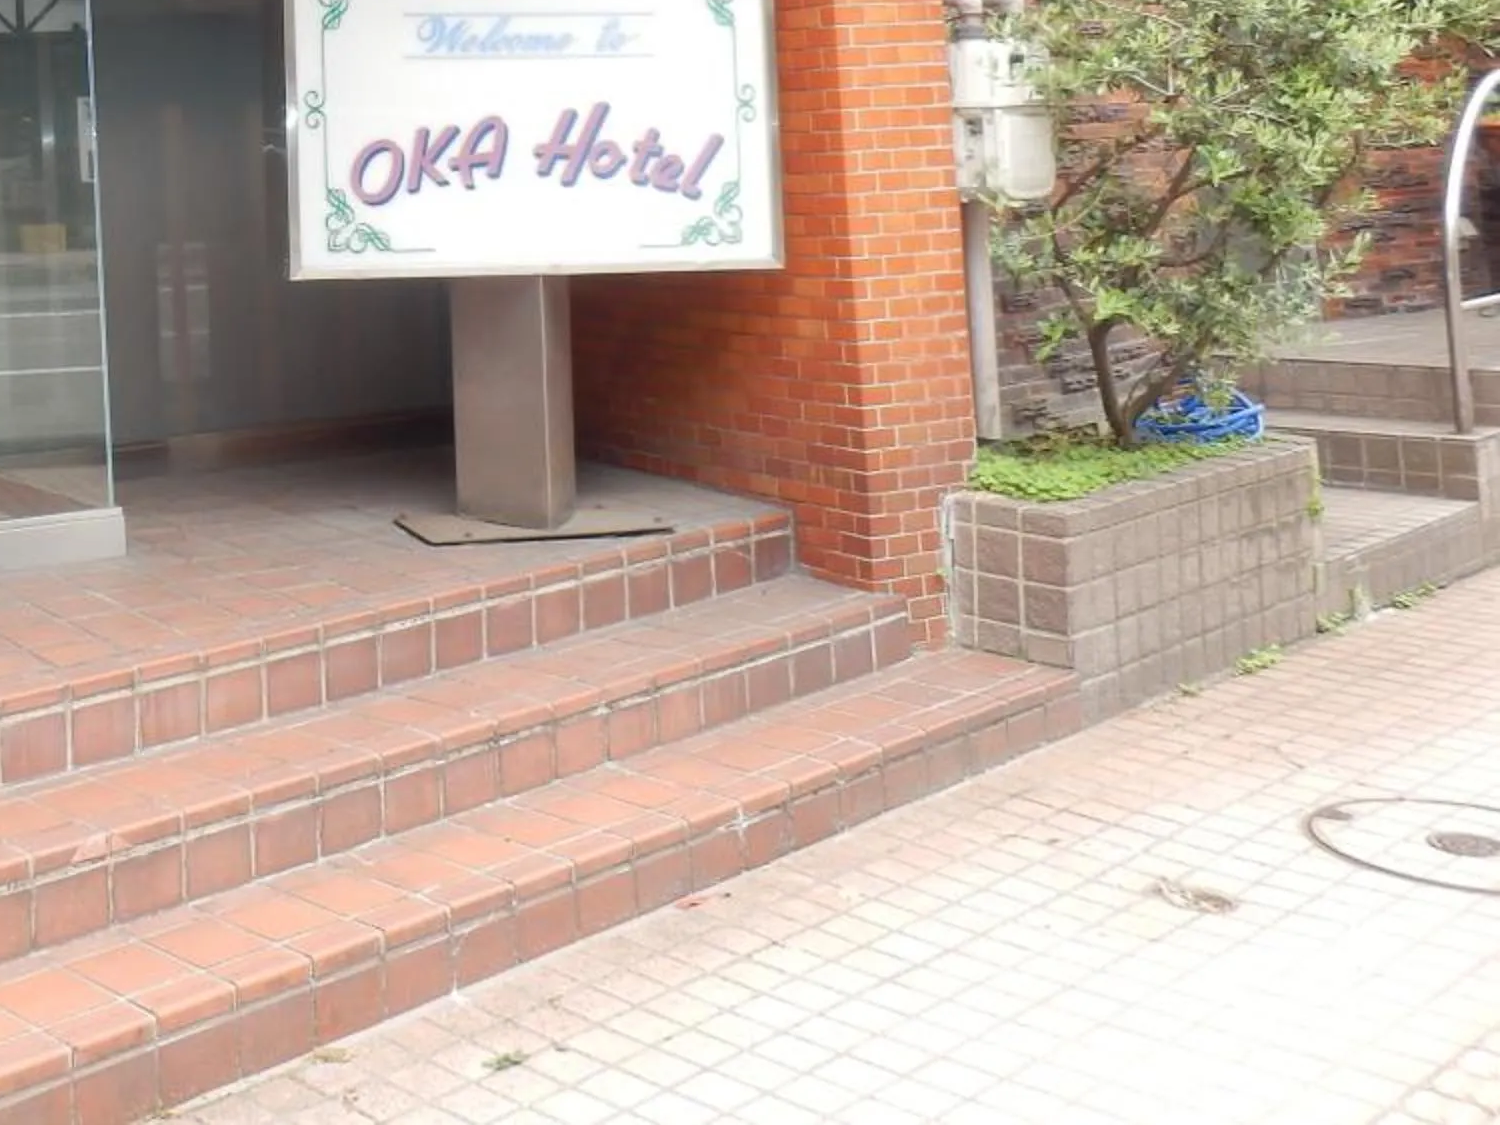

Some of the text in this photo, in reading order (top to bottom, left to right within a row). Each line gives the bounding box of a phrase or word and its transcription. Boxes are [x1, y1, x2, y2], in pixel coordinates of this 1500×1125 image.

[416, 14, 641, 54] Welcome to
[349, 101, 724, 207] OKA Hotel
